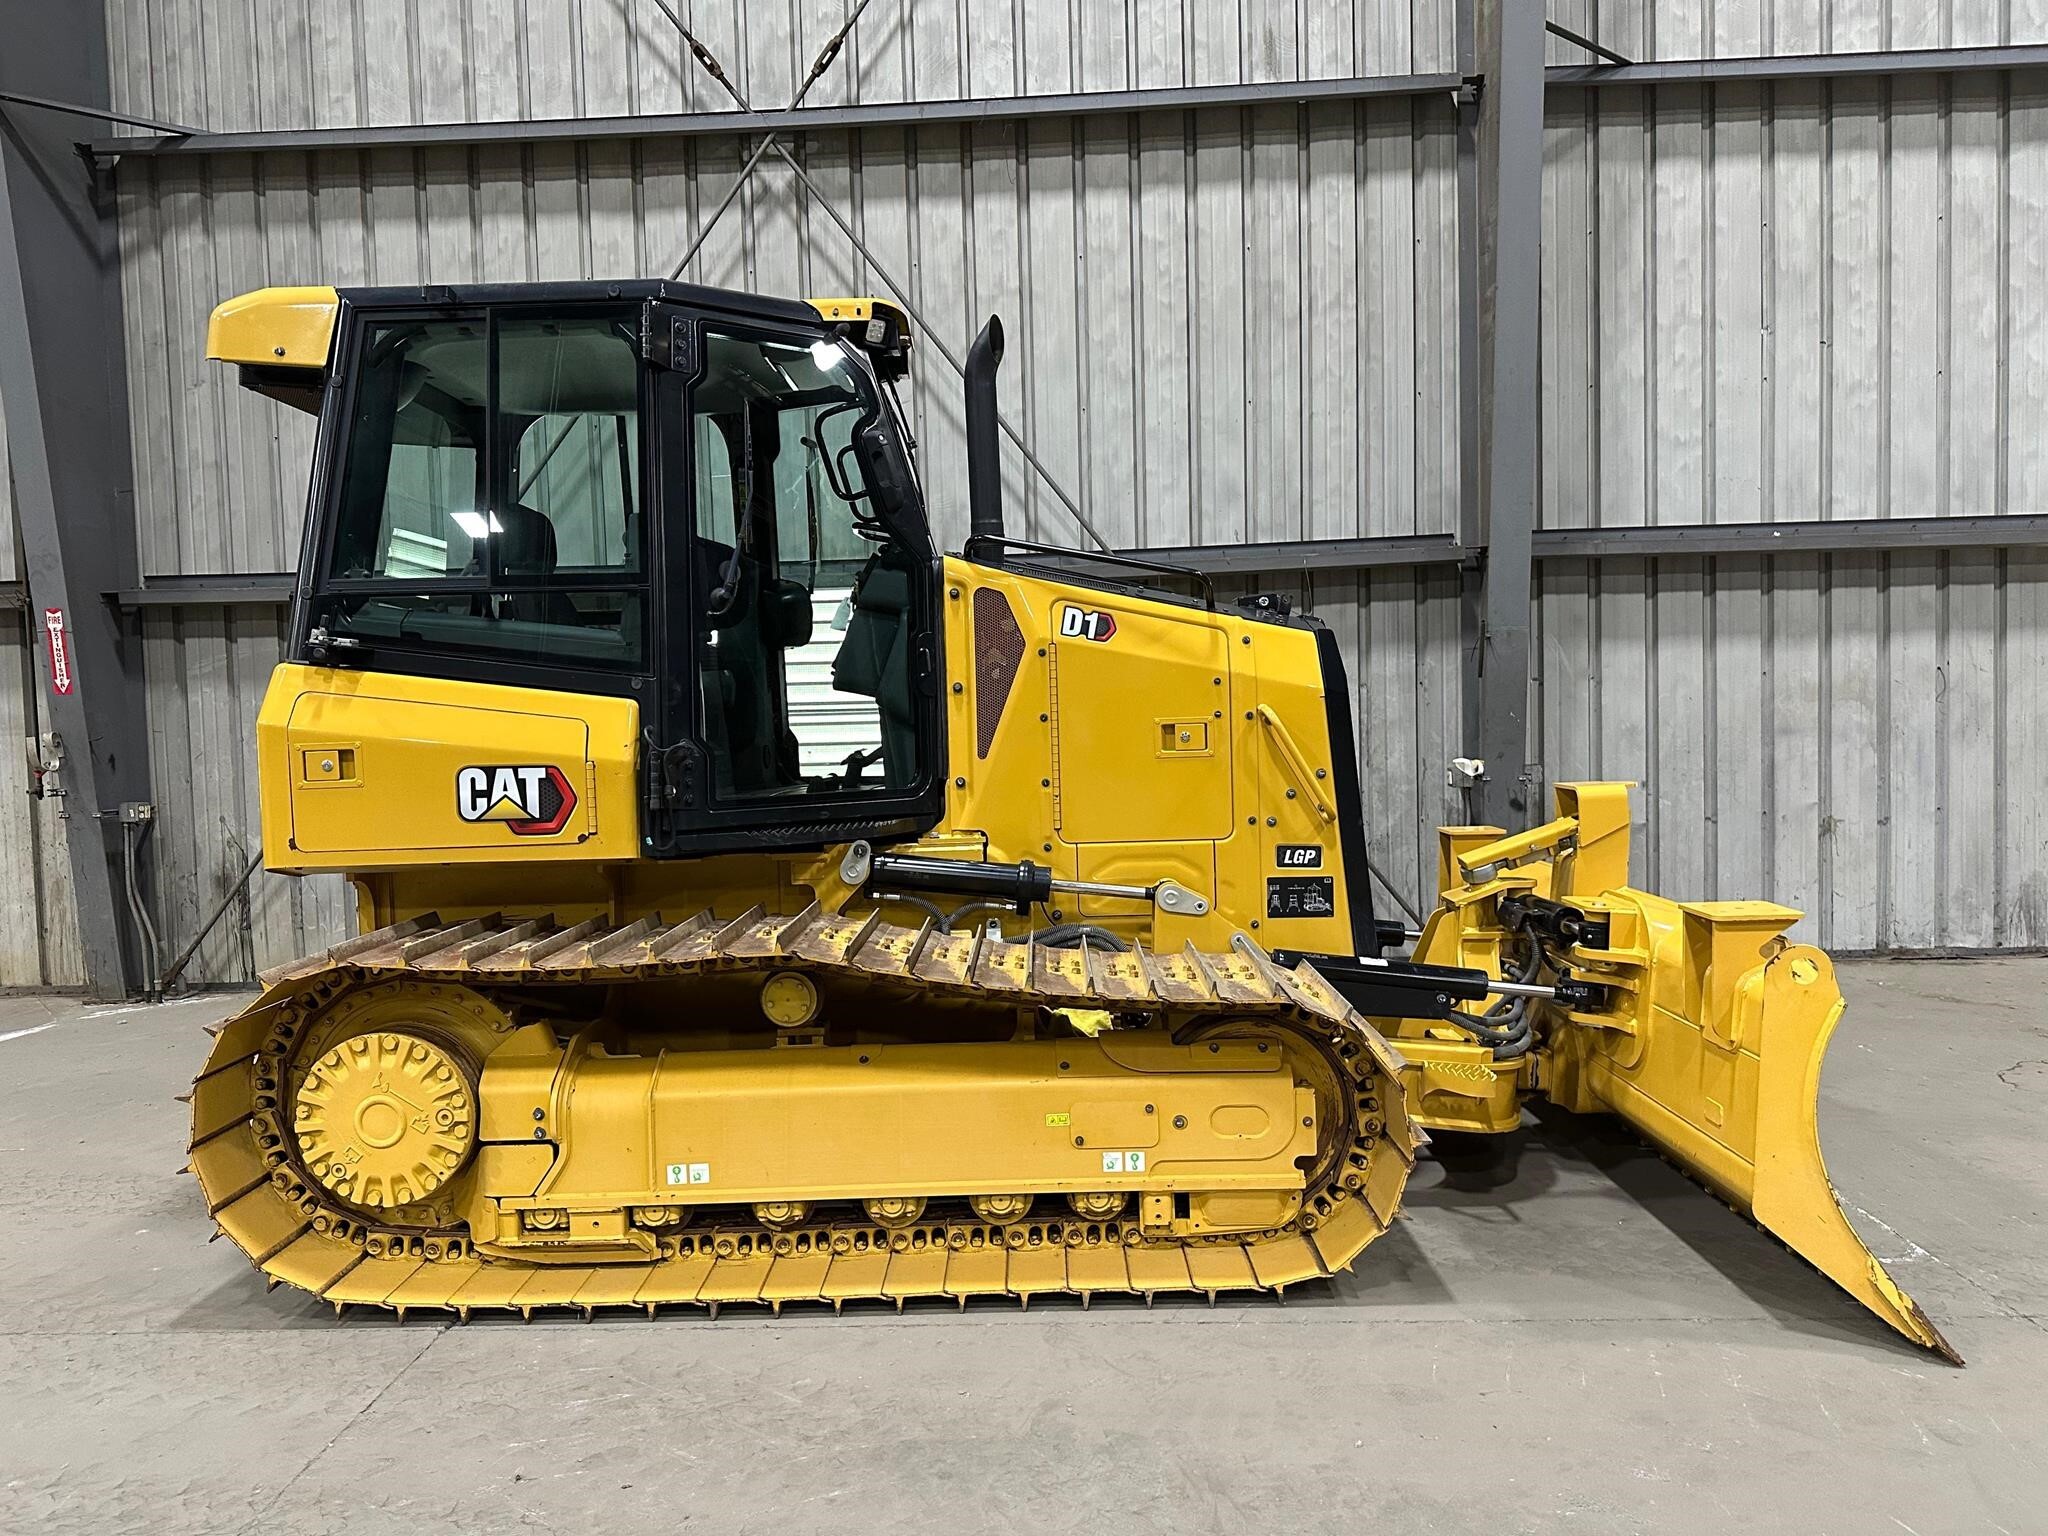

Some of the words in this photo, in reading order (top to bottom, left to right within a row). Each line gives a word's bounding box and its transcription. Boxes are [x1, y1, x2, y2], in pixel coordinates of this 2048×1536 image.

[48, 616, 61, 624] FIRE
[1062, 607, 1099, 639] D1
[53, 627, 66, 689] EXTINGUISHER
[459, 767, 546, 820] CAT
[1284, 849, 1316, 864] LGP
